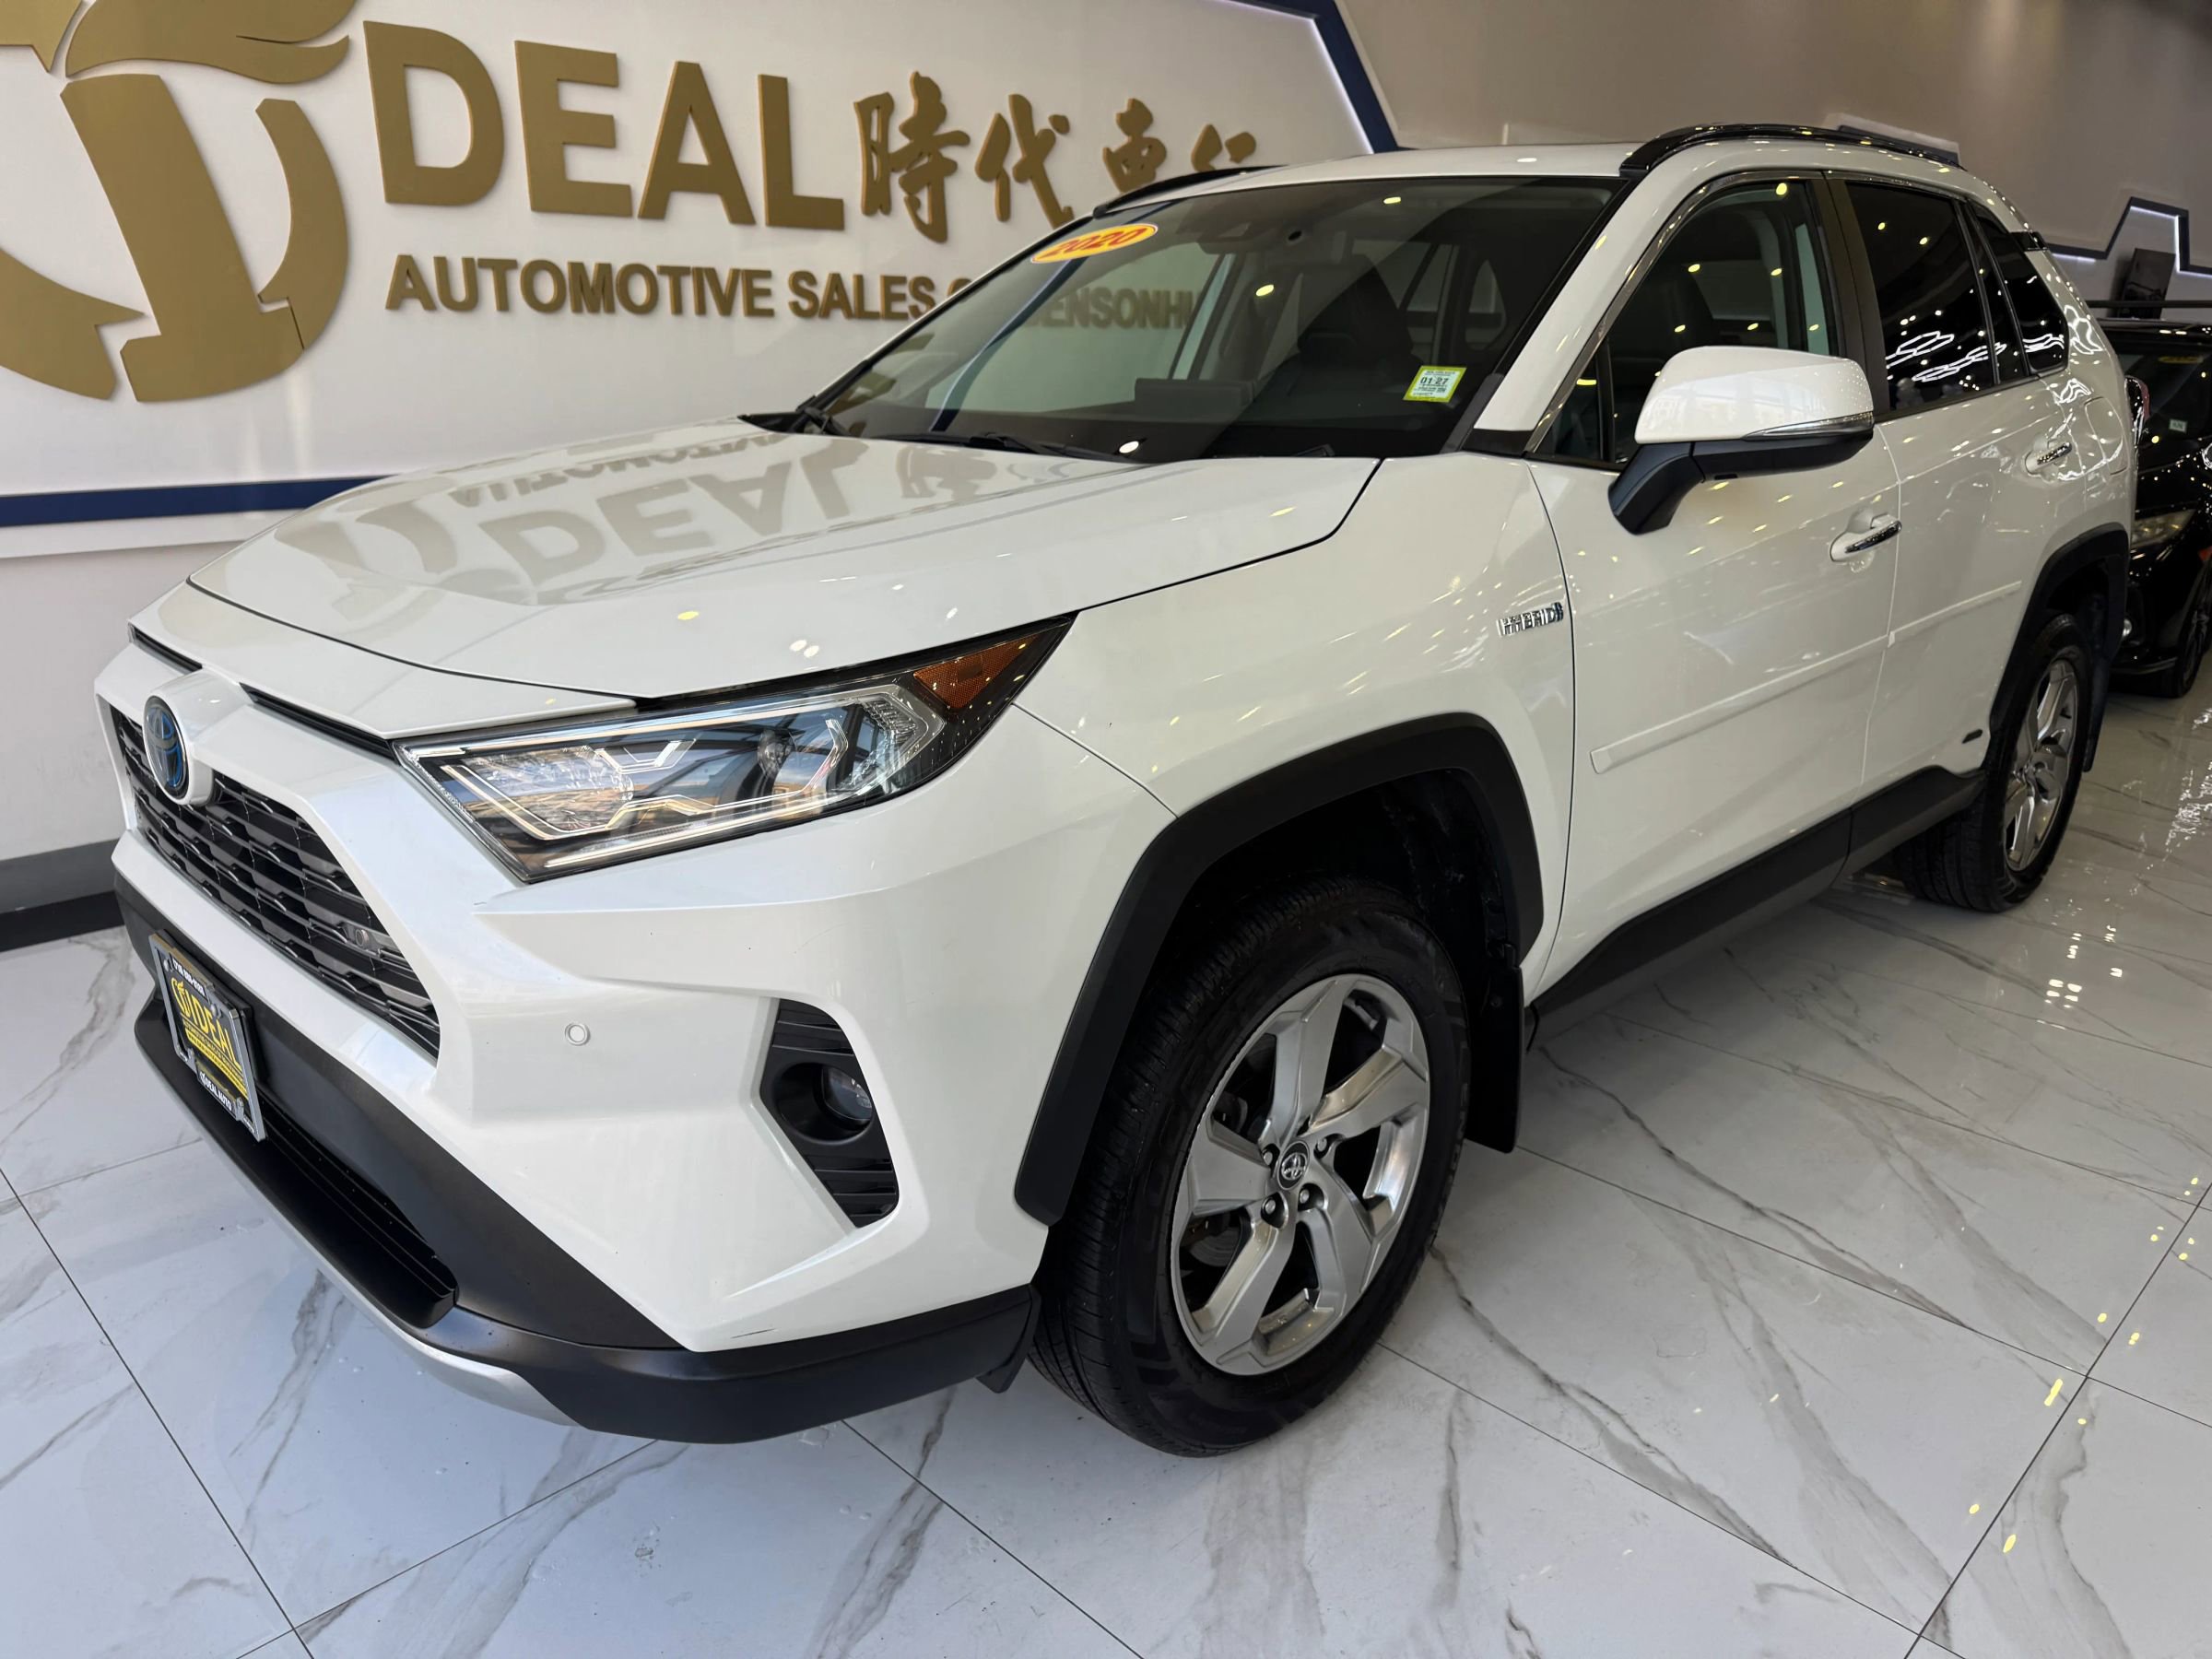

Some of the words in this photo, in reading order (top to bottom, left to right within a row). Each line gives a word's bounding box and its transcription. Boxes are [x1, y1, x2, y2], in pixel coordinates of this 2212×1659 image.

[1039, 227, 1148, 260] 2020
[385, 253, 774, 317] AUTOMOTIVE
[788, 273, 936, 321] SALES
[1496, 601, 1564, 638] HYBRID
